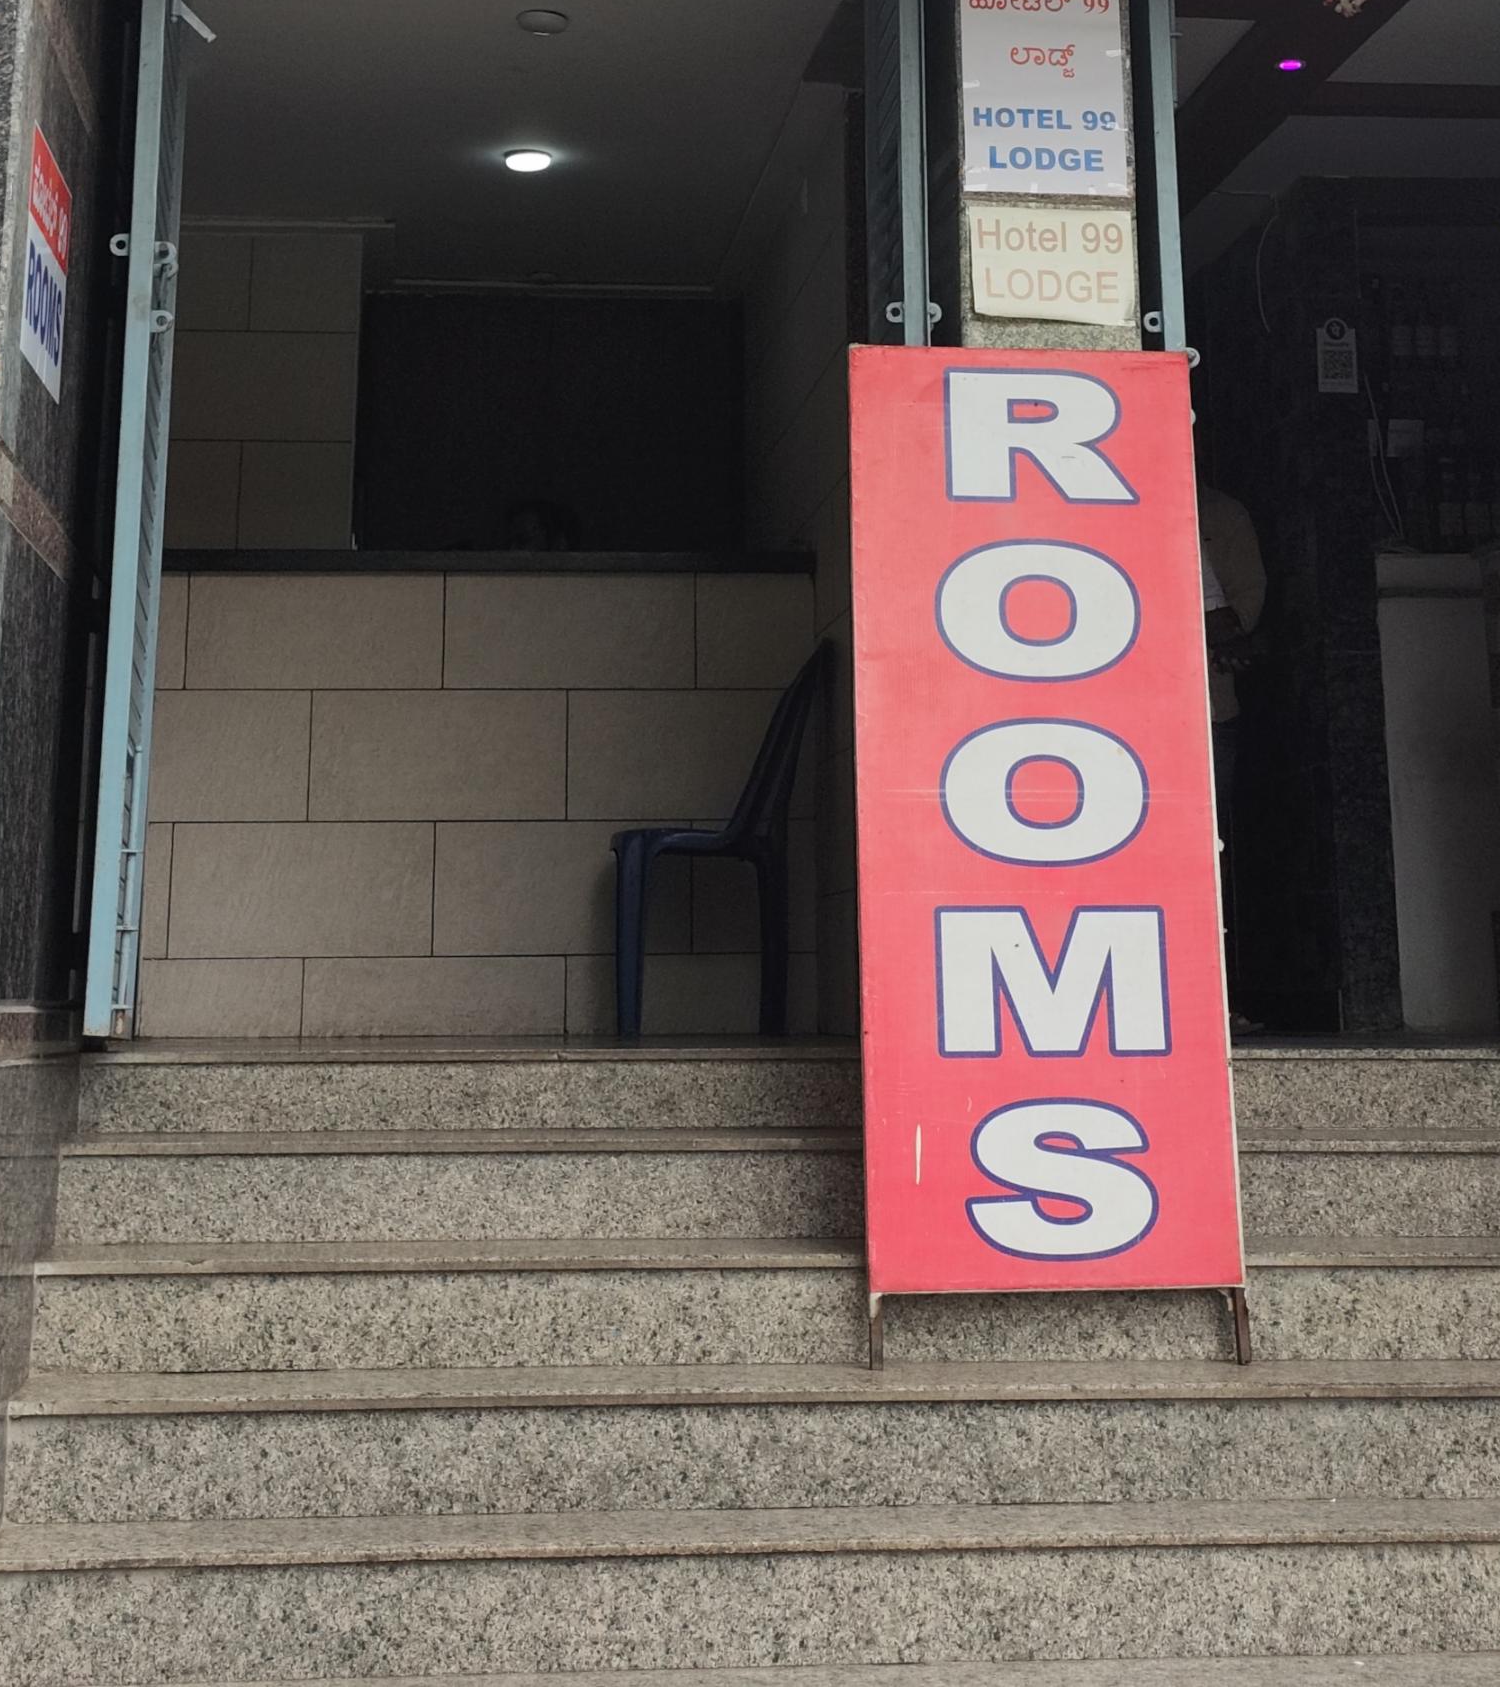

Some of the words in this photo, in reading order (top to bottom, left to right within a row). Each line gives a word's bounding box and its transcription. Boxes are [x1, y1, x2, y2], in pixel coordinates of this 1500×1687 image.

[972, 106, 1072, 130] HOTEL
[1082, 110, 1116, 132] 99
[988, 146, 1105, 172] LODGE
[975, 218, 1067, 253] Hotel
[1081, 222, 1124, 255] 99
[25, 238, 62, 368] ROOMS
[985, 266, 1120, 304] LODGE
[933, 366, 1174, 1263] ROOMS
